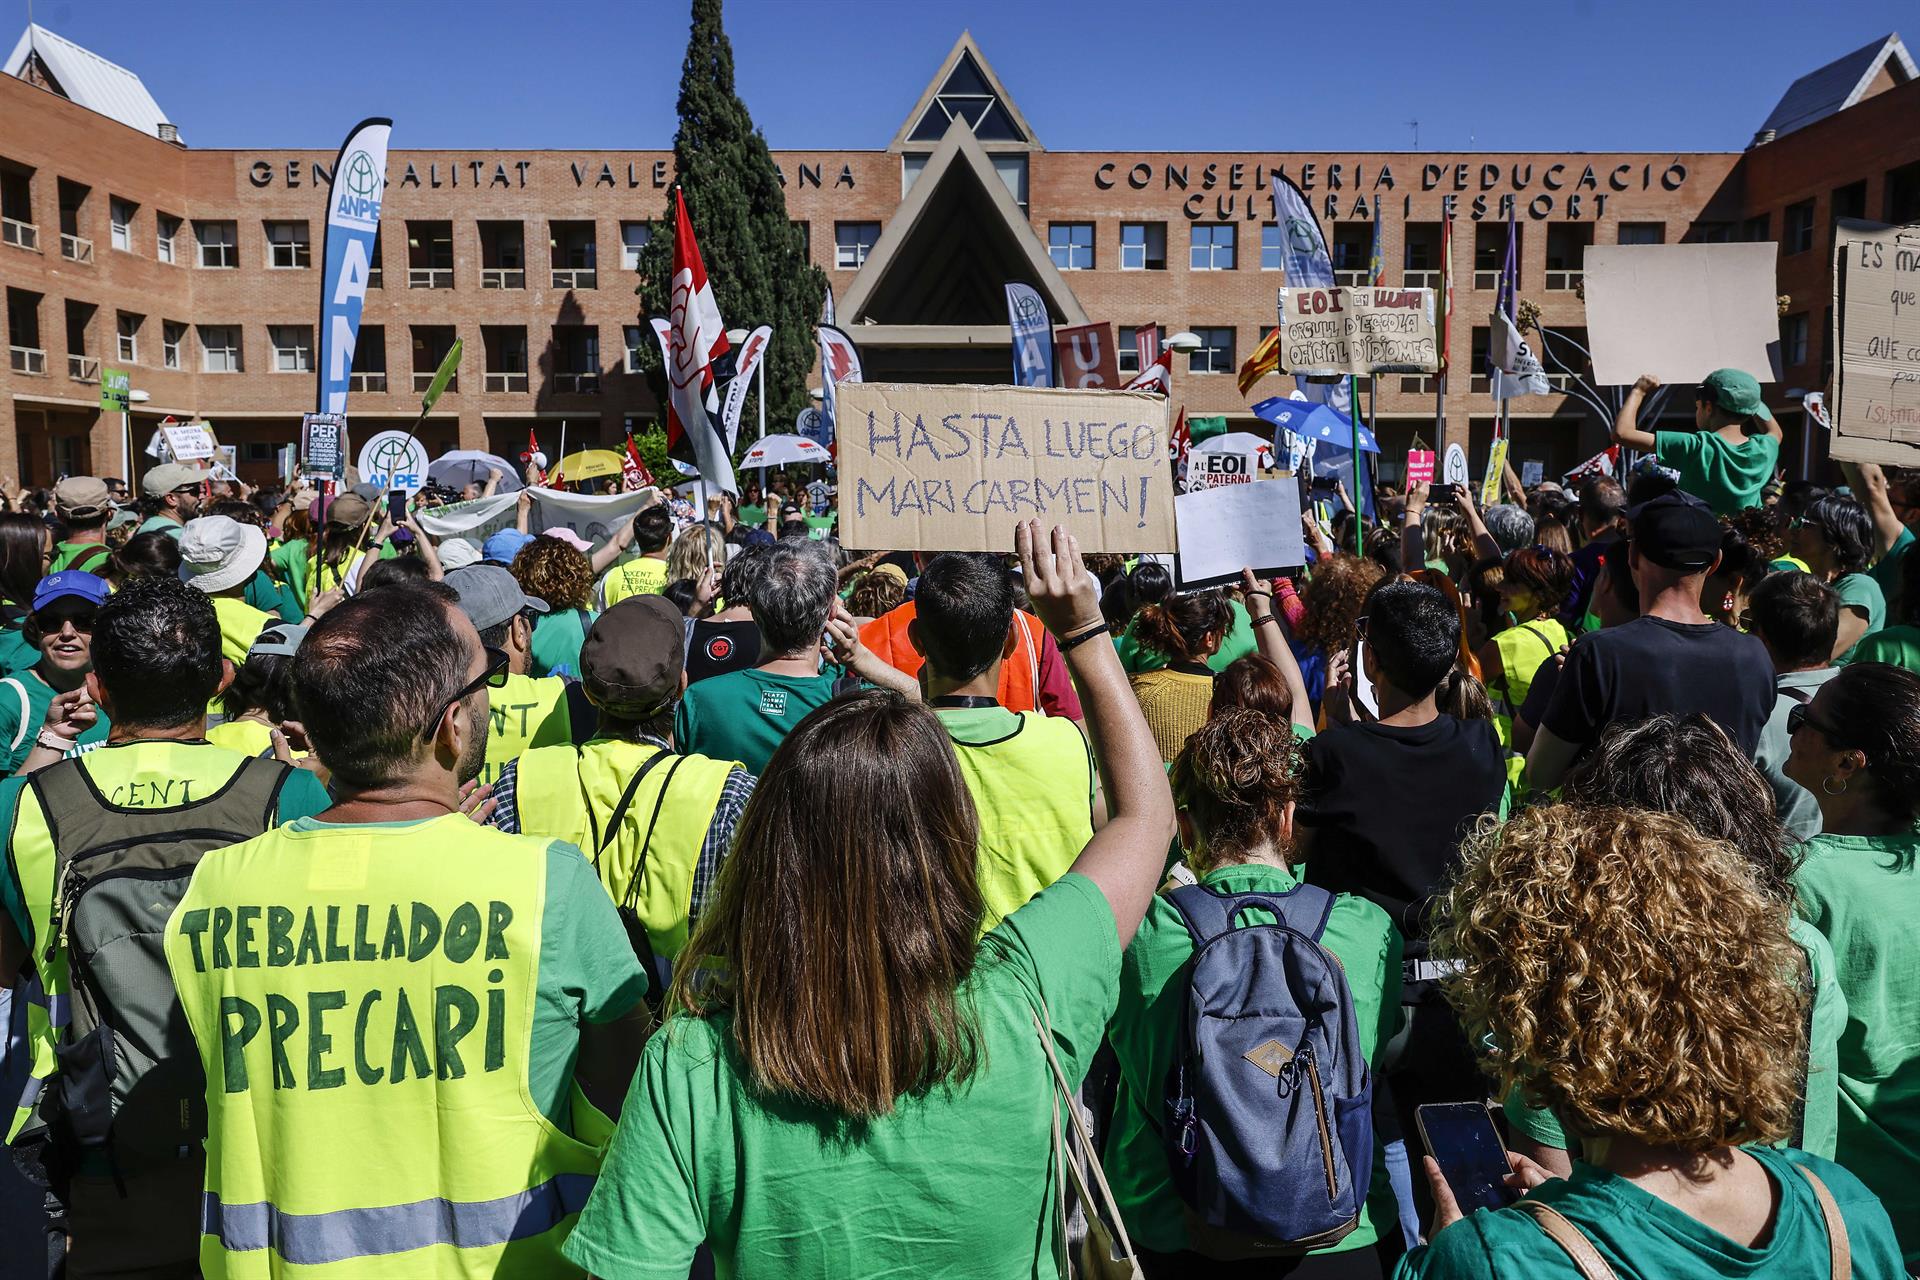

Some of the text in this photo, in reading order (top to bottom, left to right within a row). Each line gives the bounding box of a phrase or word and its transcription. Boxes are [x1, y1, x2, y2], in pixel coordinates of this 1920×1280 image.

[249, 160, 856, 189] GENALITAT VALEANA
[1094, 156, 1689, 192] CONSELERIA D'EDUCACIÓ
[337, 193, 380, 220] ANPE
[1861, 241, 1883, 269] ES
[1297, 289, 1344, 315] EOI
[1374, 290, 1422, 310] LLUITA
[1288, 313, 1419, 342] ORGULL D'ESCOLA
[1868, 336, 1900, 360] QUE
[310, 424, 337, 438] PER
[868, 410, 1029, 461] HASTA
[1206, 473, 1251, 484] PATERNA
[179, 900, 515, 974] TREBALLADOR
